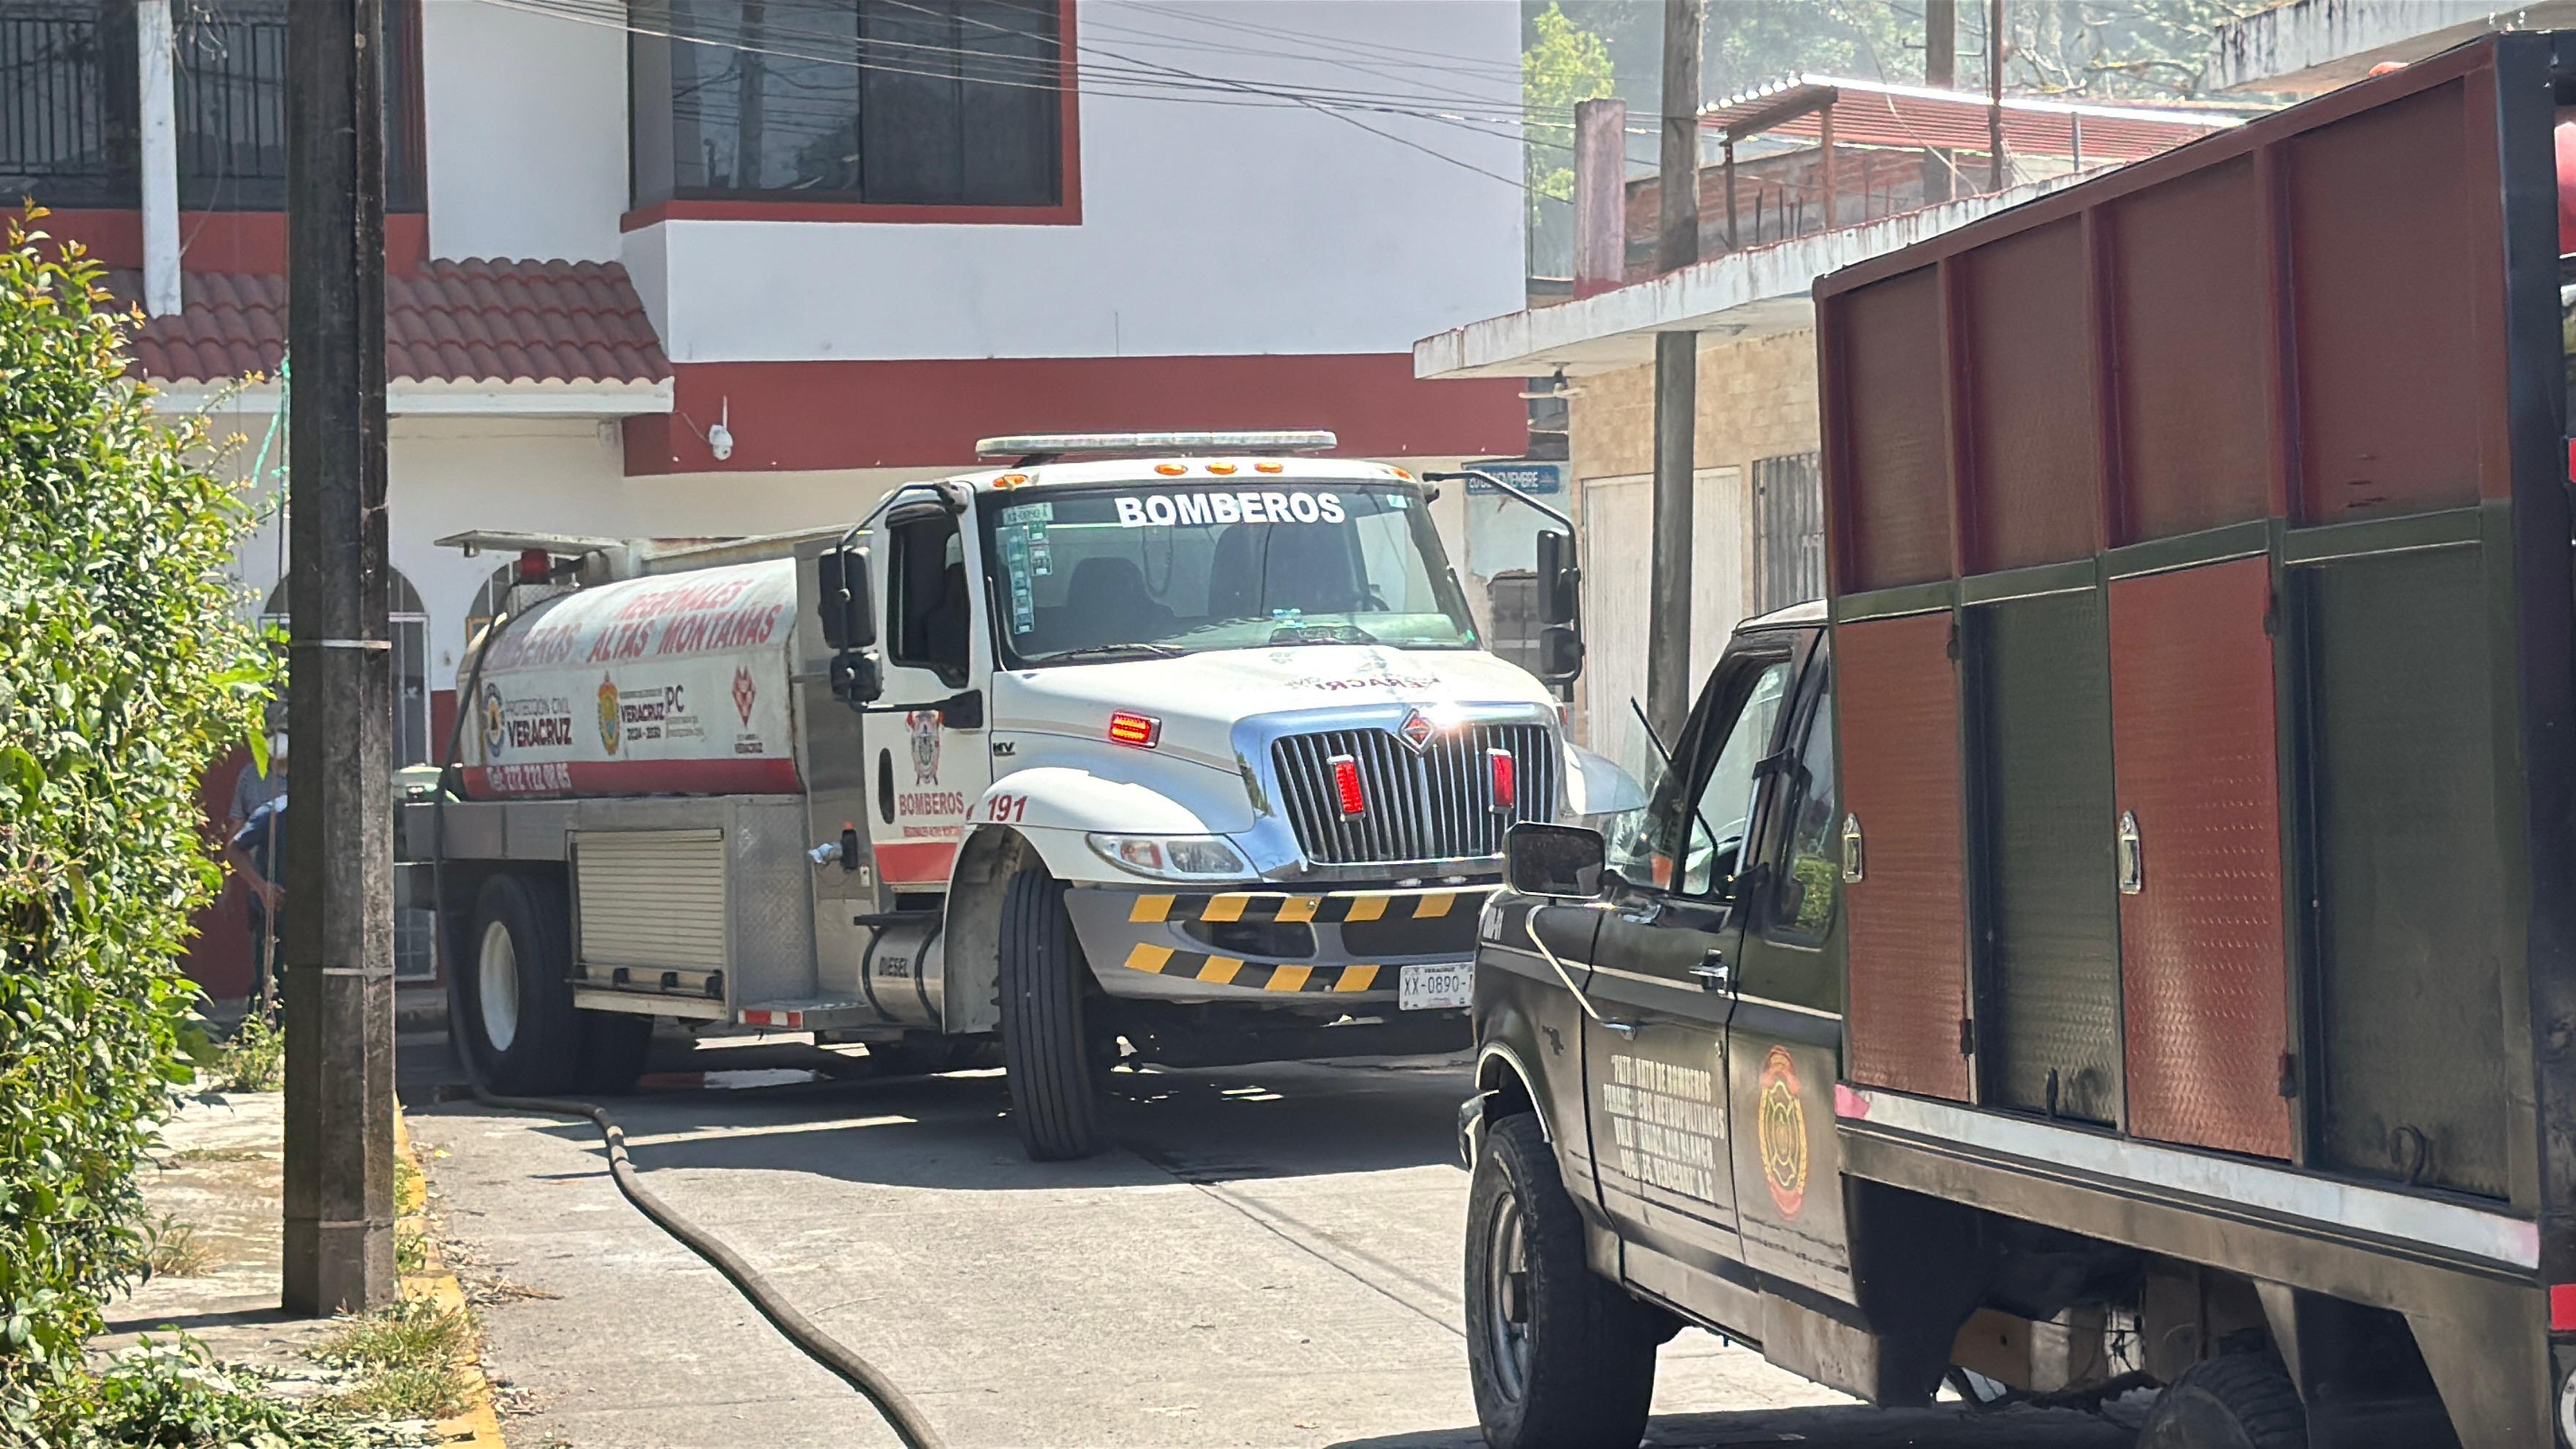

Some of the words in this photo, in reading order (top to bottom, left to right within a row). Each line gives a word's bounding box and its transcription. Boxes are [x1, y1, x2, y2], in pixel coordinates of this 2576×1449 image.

[1114, 493, 1345, 527] BOMBEROS
[588, 618, 657, 662] ALTAS
[657, 602, 782, 655] MONTAÑAS
[621, 702, 664, 723] VERACRUZ
[665, 684, 685, 714] PC
[507, 717, 572, 748] VERACRUZ
[899, 792, 965, 816] BOMBEROS
[989, 794, 1028, 822] 191
[879, 956, 909, 978] DIESEL
